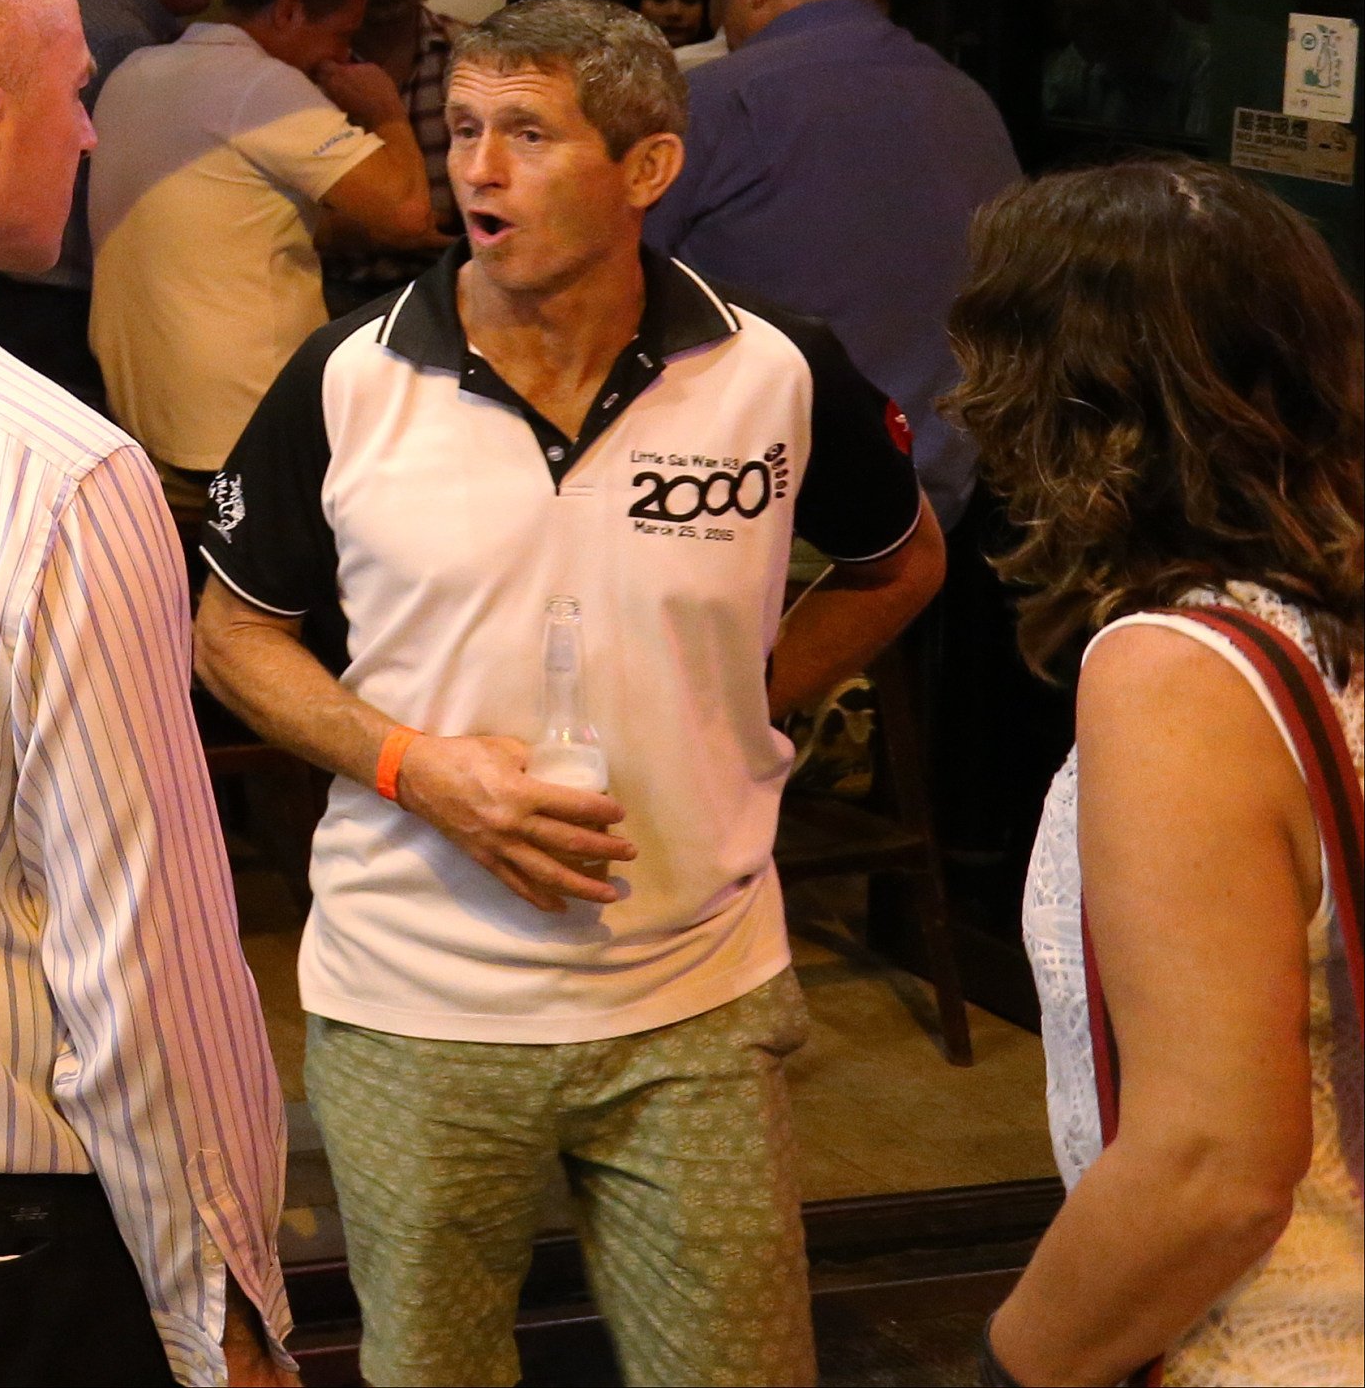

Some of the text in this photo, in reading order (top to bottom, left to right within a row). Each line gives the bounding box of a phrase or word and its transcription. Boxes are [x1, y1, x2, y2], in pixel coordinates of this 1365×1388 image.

[630, 449, 665, 465] Little
[668, 453, 688, 467] Sai
[692, 454, 719, 468] Wan
[628, 460, 771, 523] 2000
